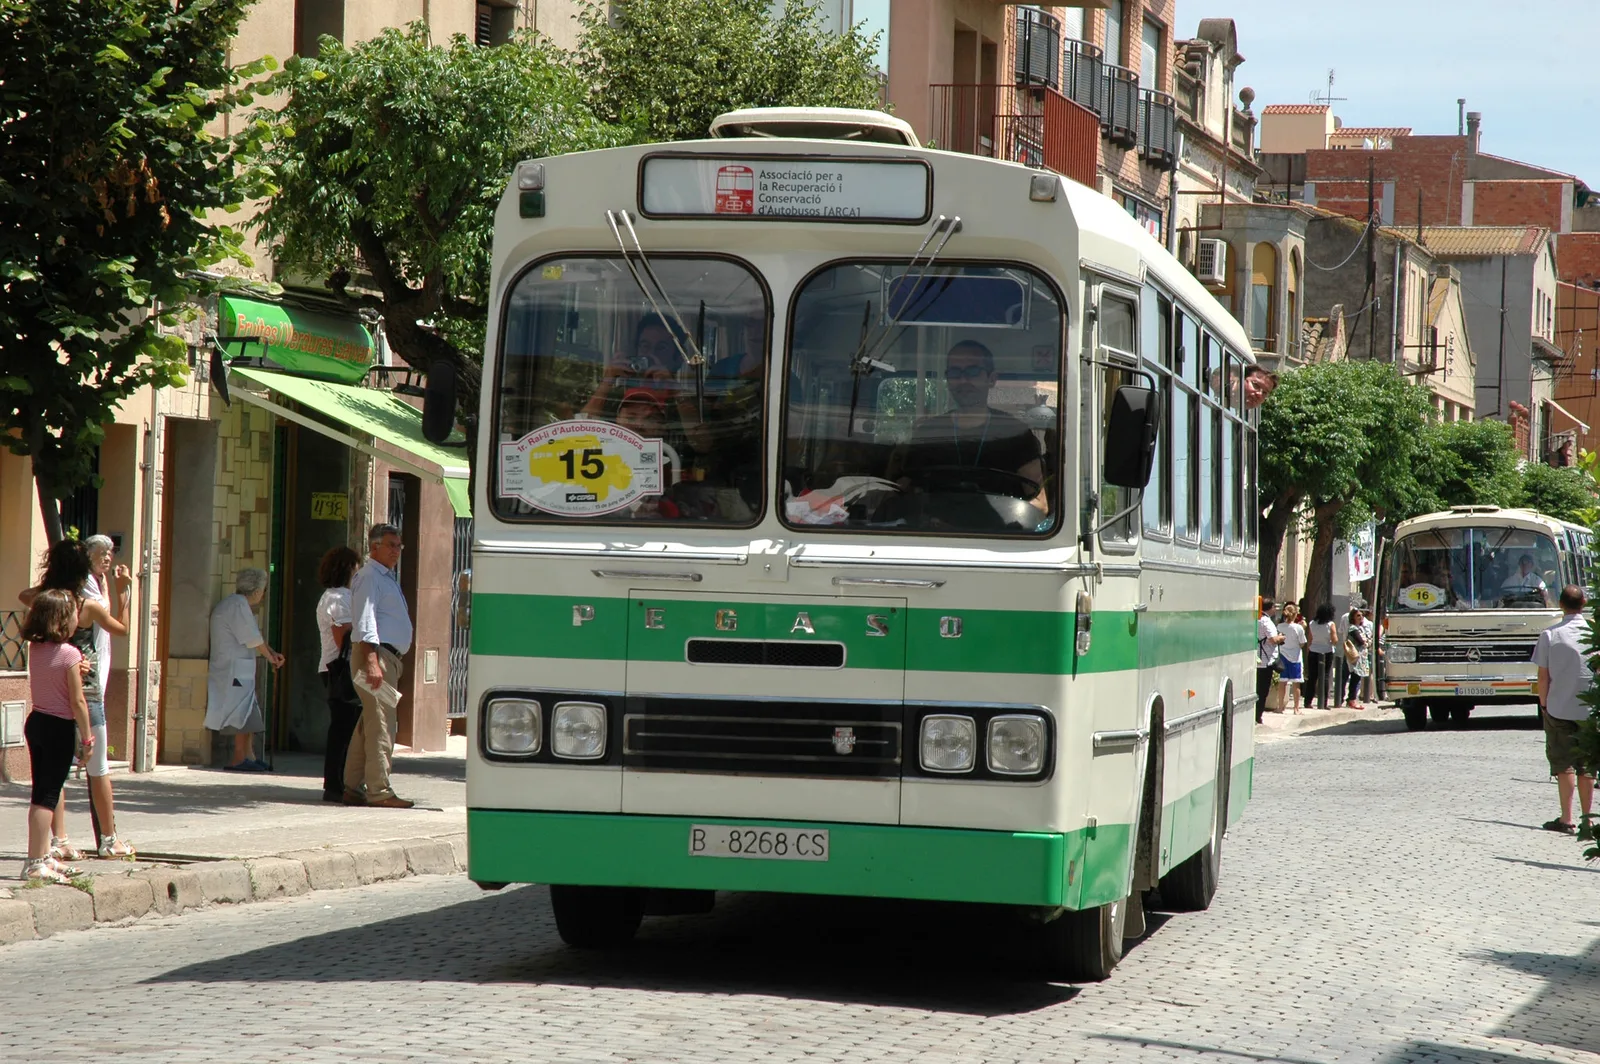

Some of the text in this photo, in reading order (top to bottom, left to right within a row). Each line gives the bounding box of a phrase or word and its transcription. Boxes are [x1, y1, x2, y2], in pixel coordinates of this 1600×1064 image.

[759, 170, 843, 183] Associació per a
[758, 193, 822, 204] Conservació
[759, 182, 842, 194] la Recuperació i
[758, 204, 820, 216] d'Autobusos
[237, 313, 278, 345] Fruites
[283, 323, 333, 357] Verdures
[516, 445, 528, 453] 1r.
[551, 424, 607, 436] d'Autobusos
[608, 428, 644, 450] Clàssics
[559, 448, 605, 480] 15
[1416, 591, 1429, 600] 16
[572, 604, 963, 639] PEGASO
[692, 828, 825, 857] B 8268 CS
